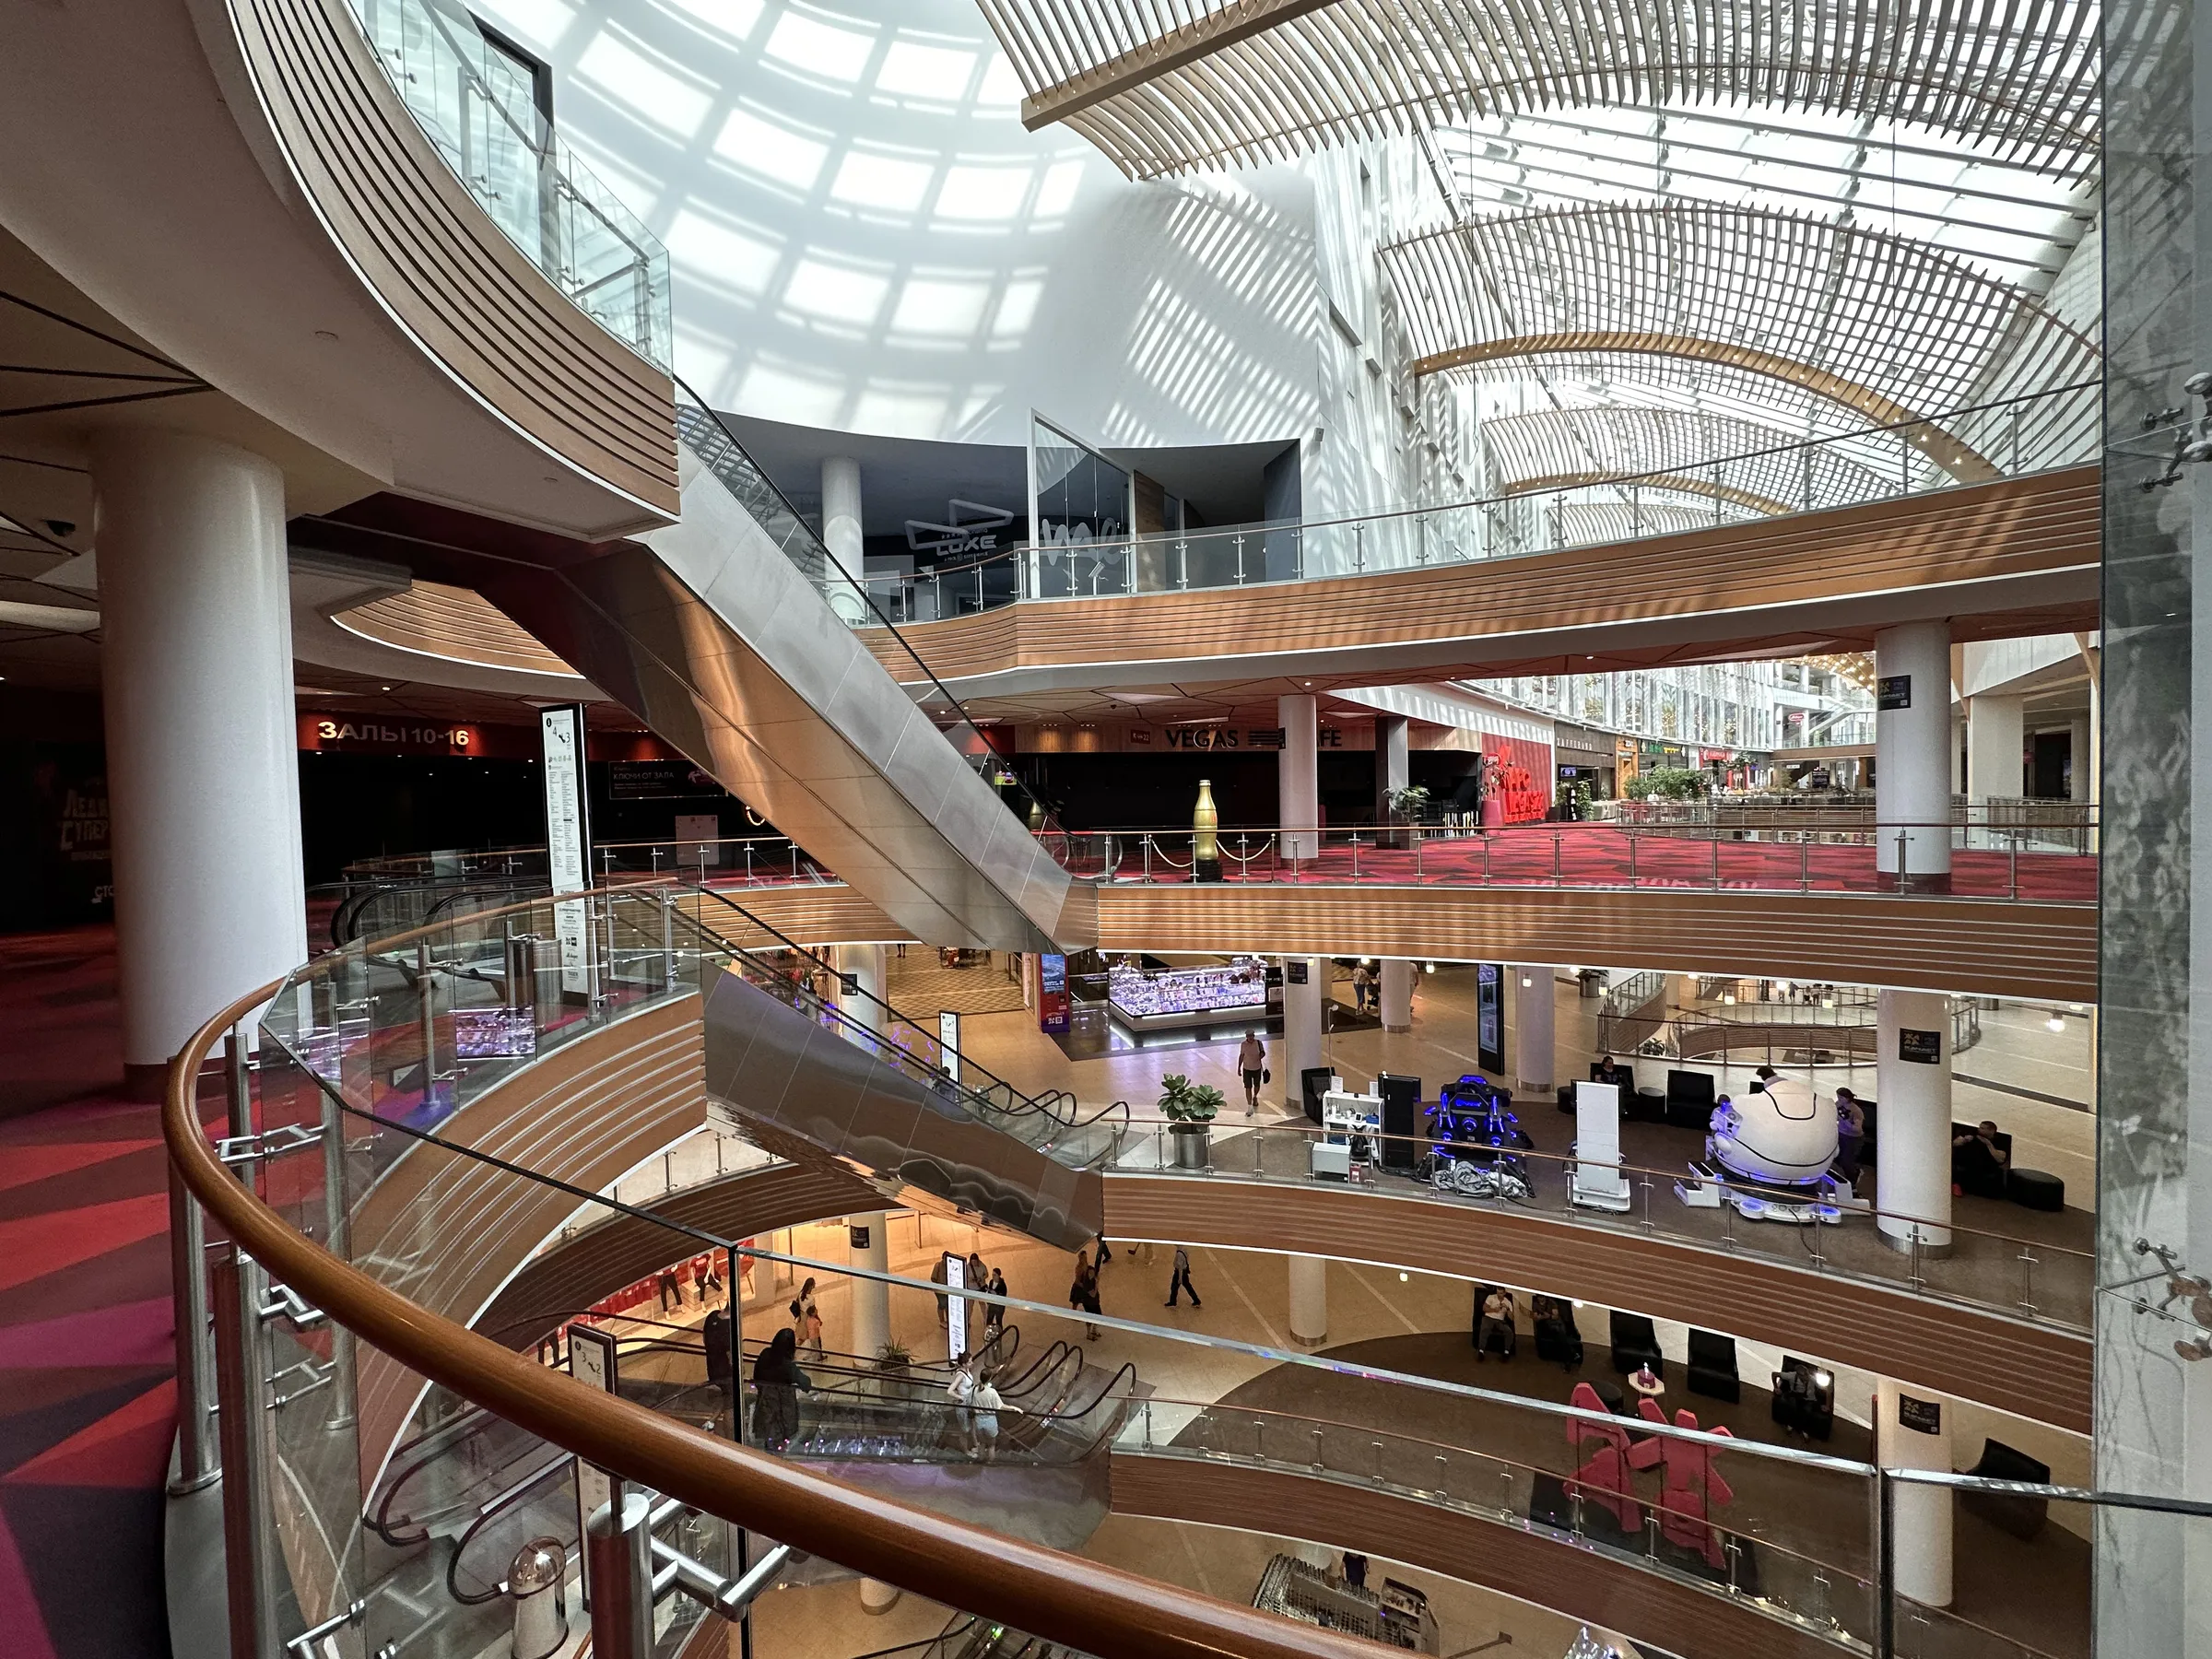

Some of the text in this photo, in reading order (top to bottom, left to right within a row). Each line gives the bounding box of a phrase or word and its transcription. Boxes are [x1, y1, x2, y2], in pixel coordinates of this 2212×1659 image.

[317, 721, 469, 746] ЗАЛЫ 10-16
[1165, 729, 1239, 747] VEGAS
[641, 771, 653, 780] ОТ
